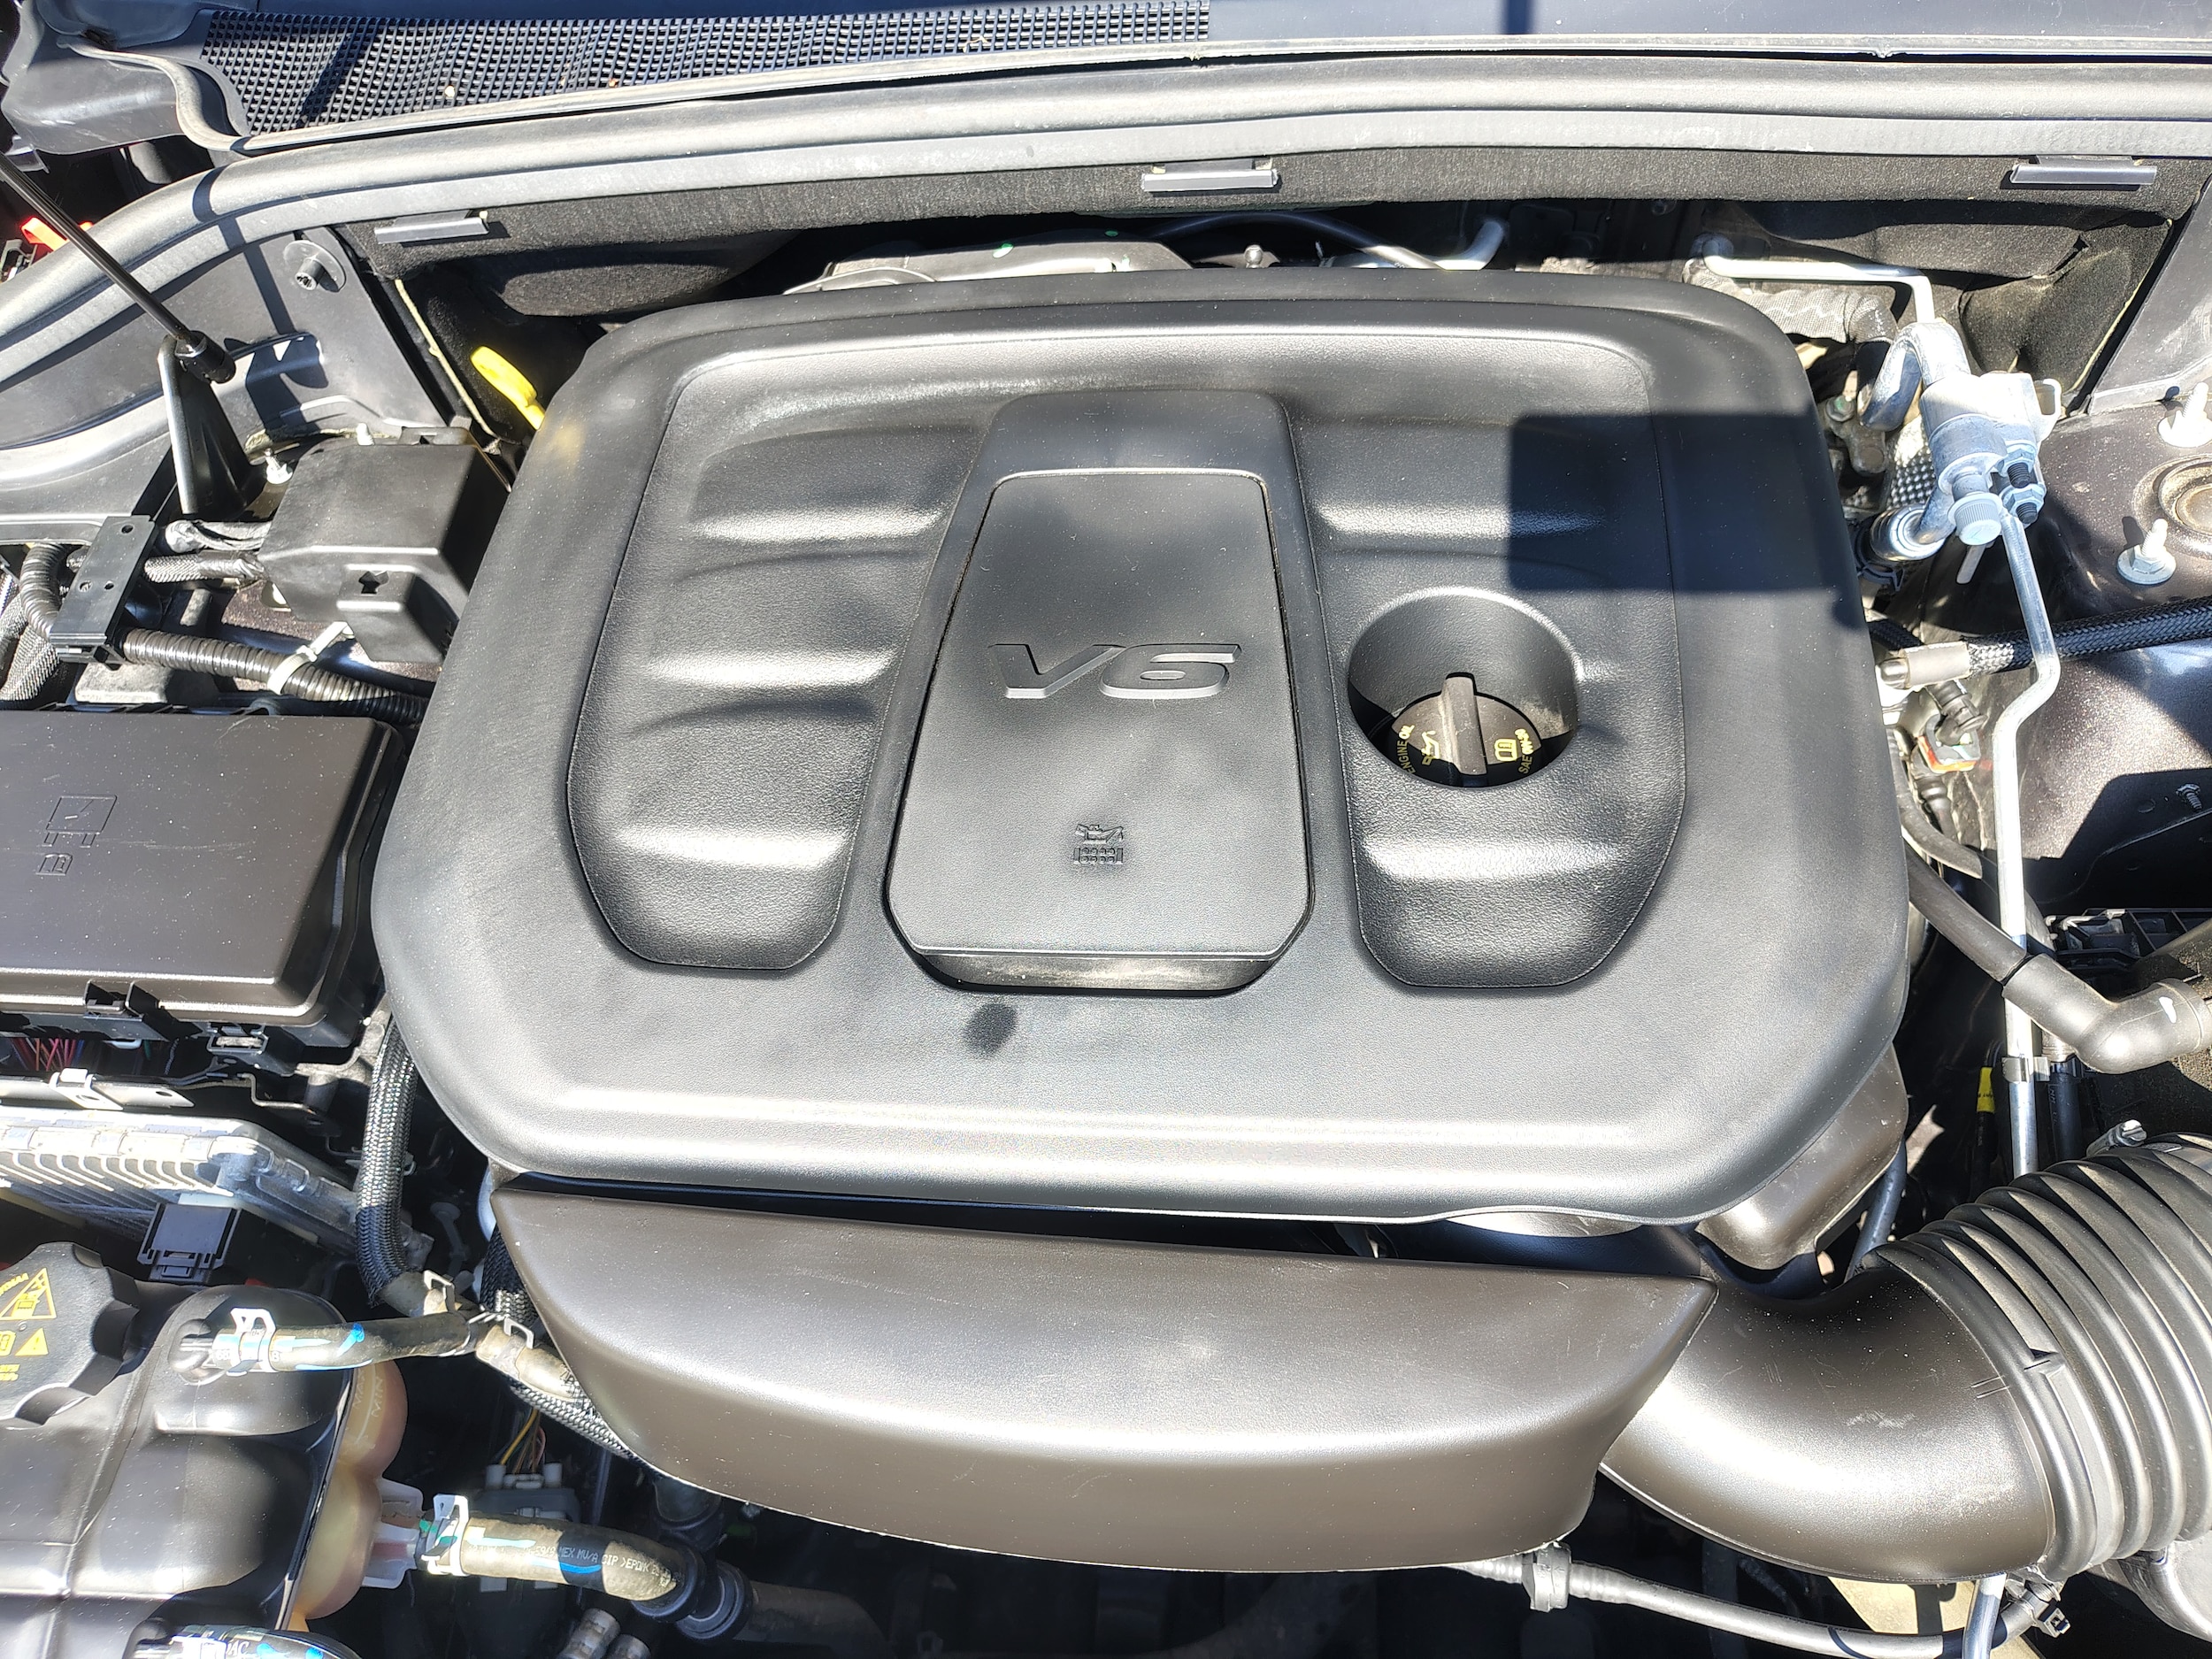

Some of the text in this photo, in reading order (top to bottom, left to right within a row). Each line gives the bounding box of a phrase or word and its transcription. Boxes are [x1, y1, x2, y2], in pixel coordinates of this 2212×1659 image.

[988, 642, 1242, 700] V6
[1397, 725, 1417, 773] ENGINE OIL
[1517, 755, 1533, 774] SAE
[371, 1376, 384, 1417] MIN
